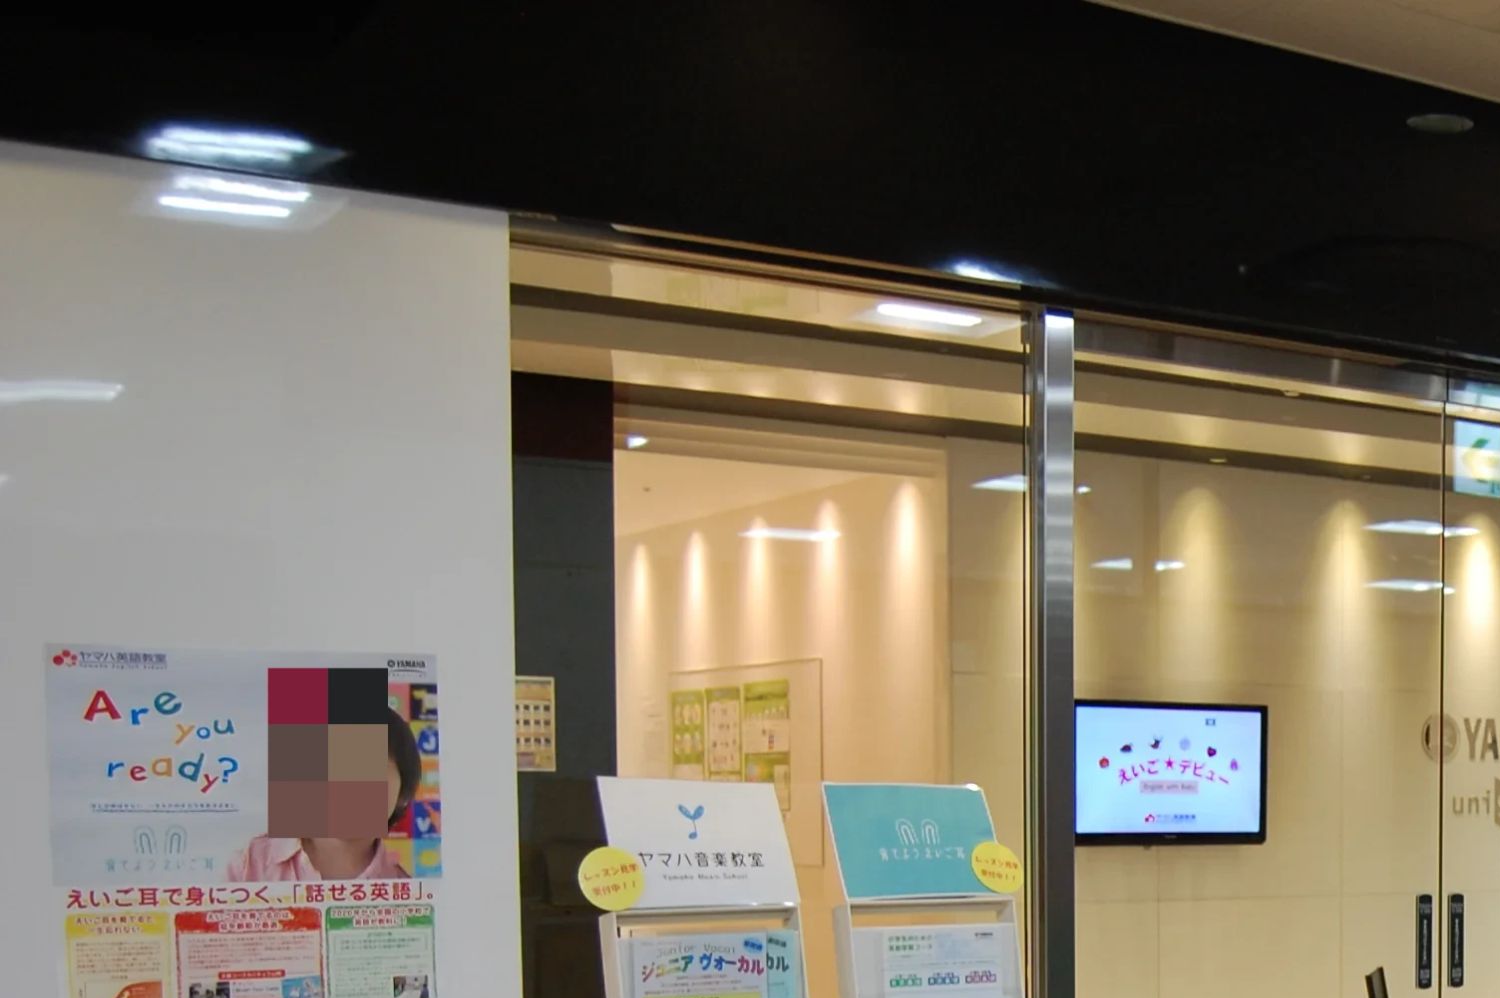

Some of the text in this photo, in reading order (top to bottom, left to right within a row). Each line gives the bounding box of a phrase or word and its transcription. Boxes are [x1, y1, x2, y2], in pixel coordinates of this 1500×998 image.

[84, 689, 183, 726] Are
[175, 718, 235, 745] you
[107, 752, 239, 793] ready?
[638, 851, 765, 868] ヤマハ音楽教室
